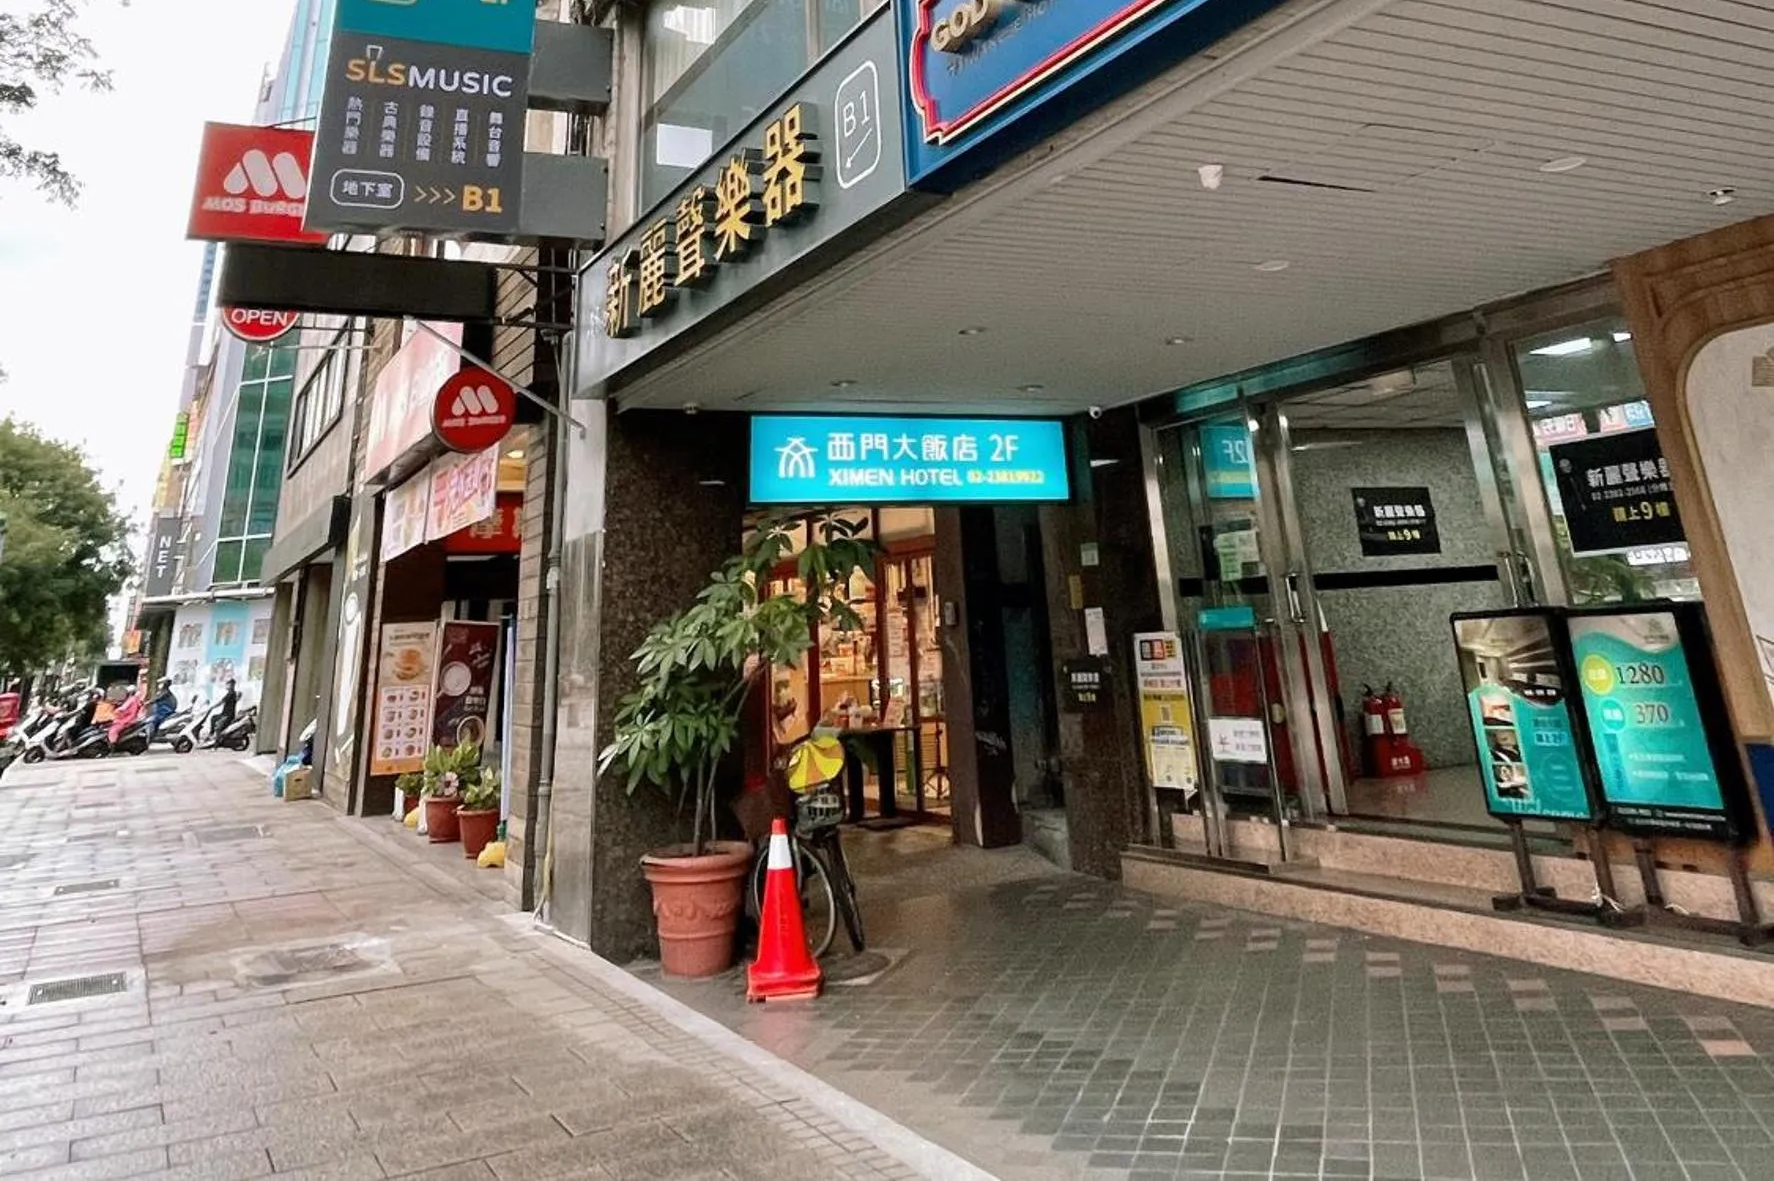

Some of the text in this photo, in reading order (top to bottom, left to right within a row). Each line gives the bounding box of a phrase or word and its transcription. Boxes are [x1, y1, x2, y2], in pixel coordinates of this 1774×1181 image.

[842, 90, 871, 138] B1
[342, 179, 394, 199] 地下室
[462, 184, 503, 214] B1
[231, 308, 288, 327] OPEN
[827, 432, 1020, 462] 西門大飯店 2F
[828, 468, 895, 487] XIMEN
[900, 468, 964, 487] HOTEL
[156, 535, 172, 579] NET
[1616, 664, 1665, 685] 1280
[1636, 704, 1669, 724] 370
